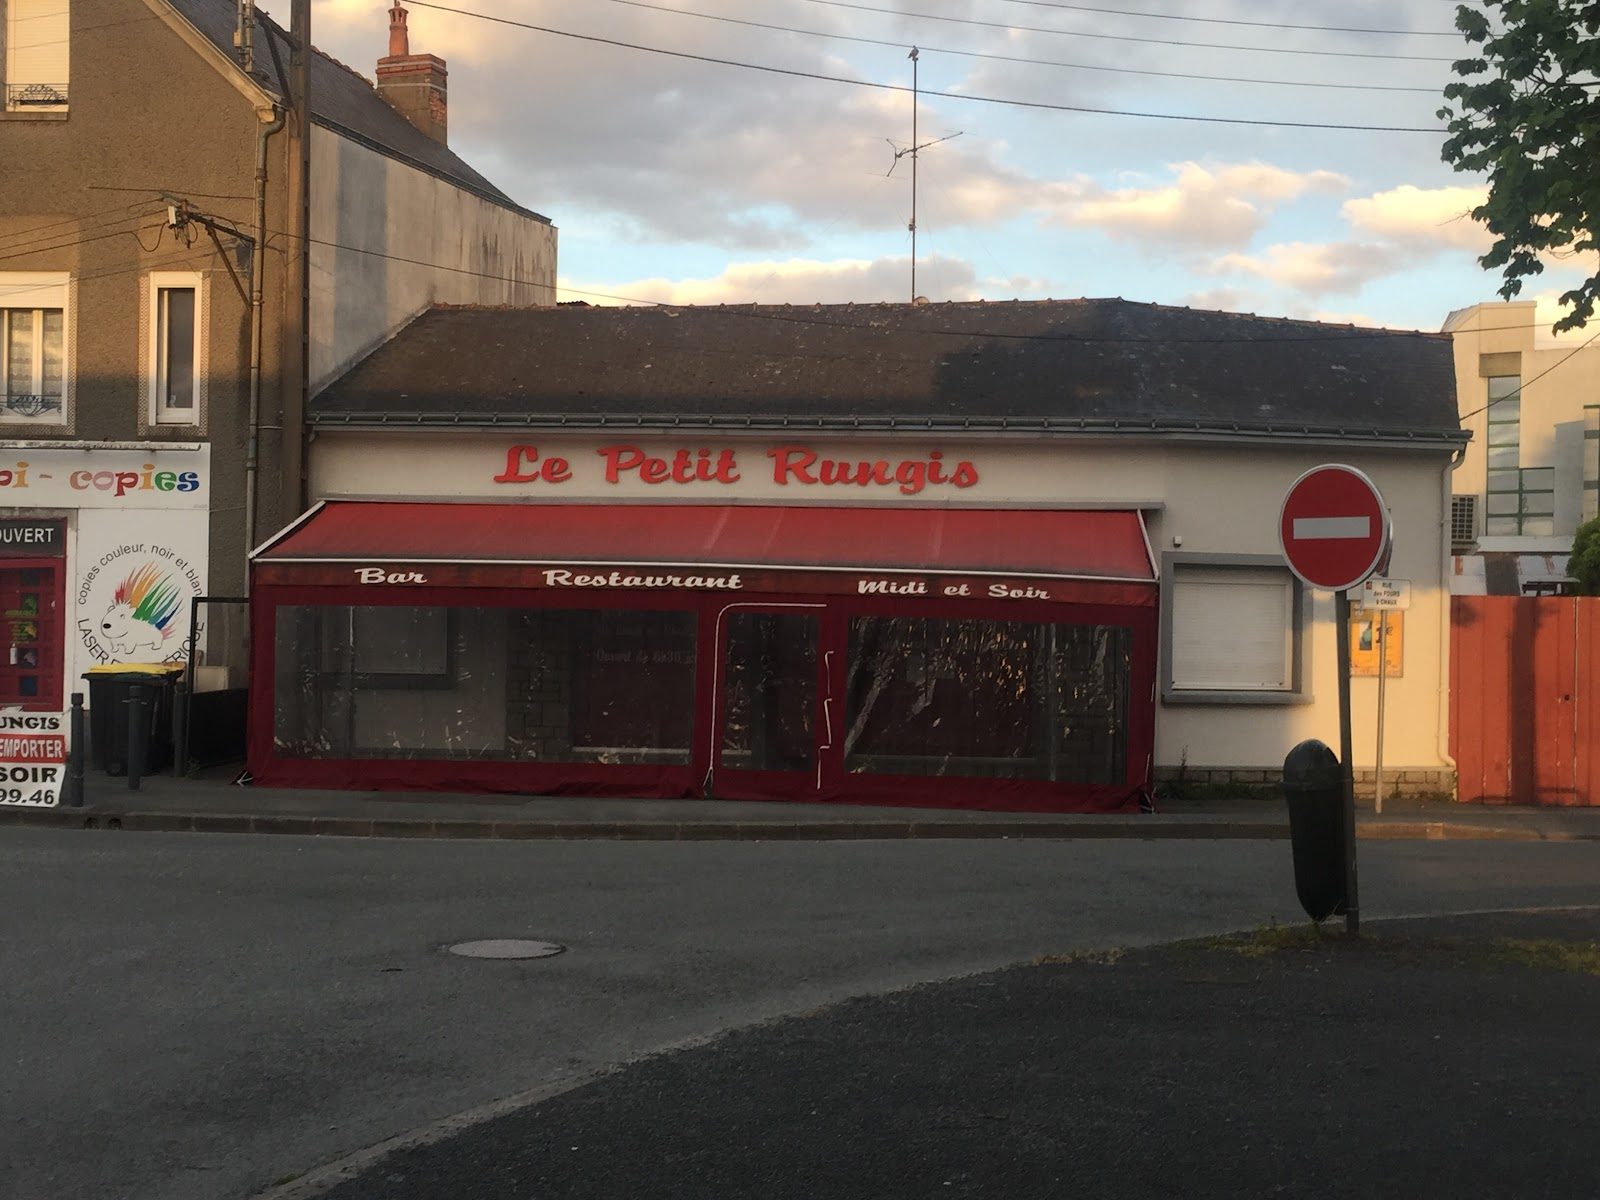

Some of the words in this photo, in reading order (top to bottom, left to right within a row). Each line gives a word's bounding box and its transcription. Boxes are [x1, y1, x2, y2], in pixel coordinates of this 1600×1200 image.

[69, 463, 200, 497] copies
[493, 444, 573, 484] Le
[597, 444, 741, 484] Petit
[766, 445, 979, 495] Rungis
[0, 528, 54, 543] UVERT
[78, 565, 101, 605] copies
[151, 544, 175, 561] noir
[175, 557, 187, 571] et
[185, 568, 203, 597] blan
[354, 567, 428, 585] Bar
[542, 569, 743, 590] Restaurant
[857, 580, 928, 595] Midi
[944, 584, 971, 596] et
[988, 584, 1050, 600] Soir
[78, 618, 110, 666] LASER
[0, 766, 57, 784] SOIR
